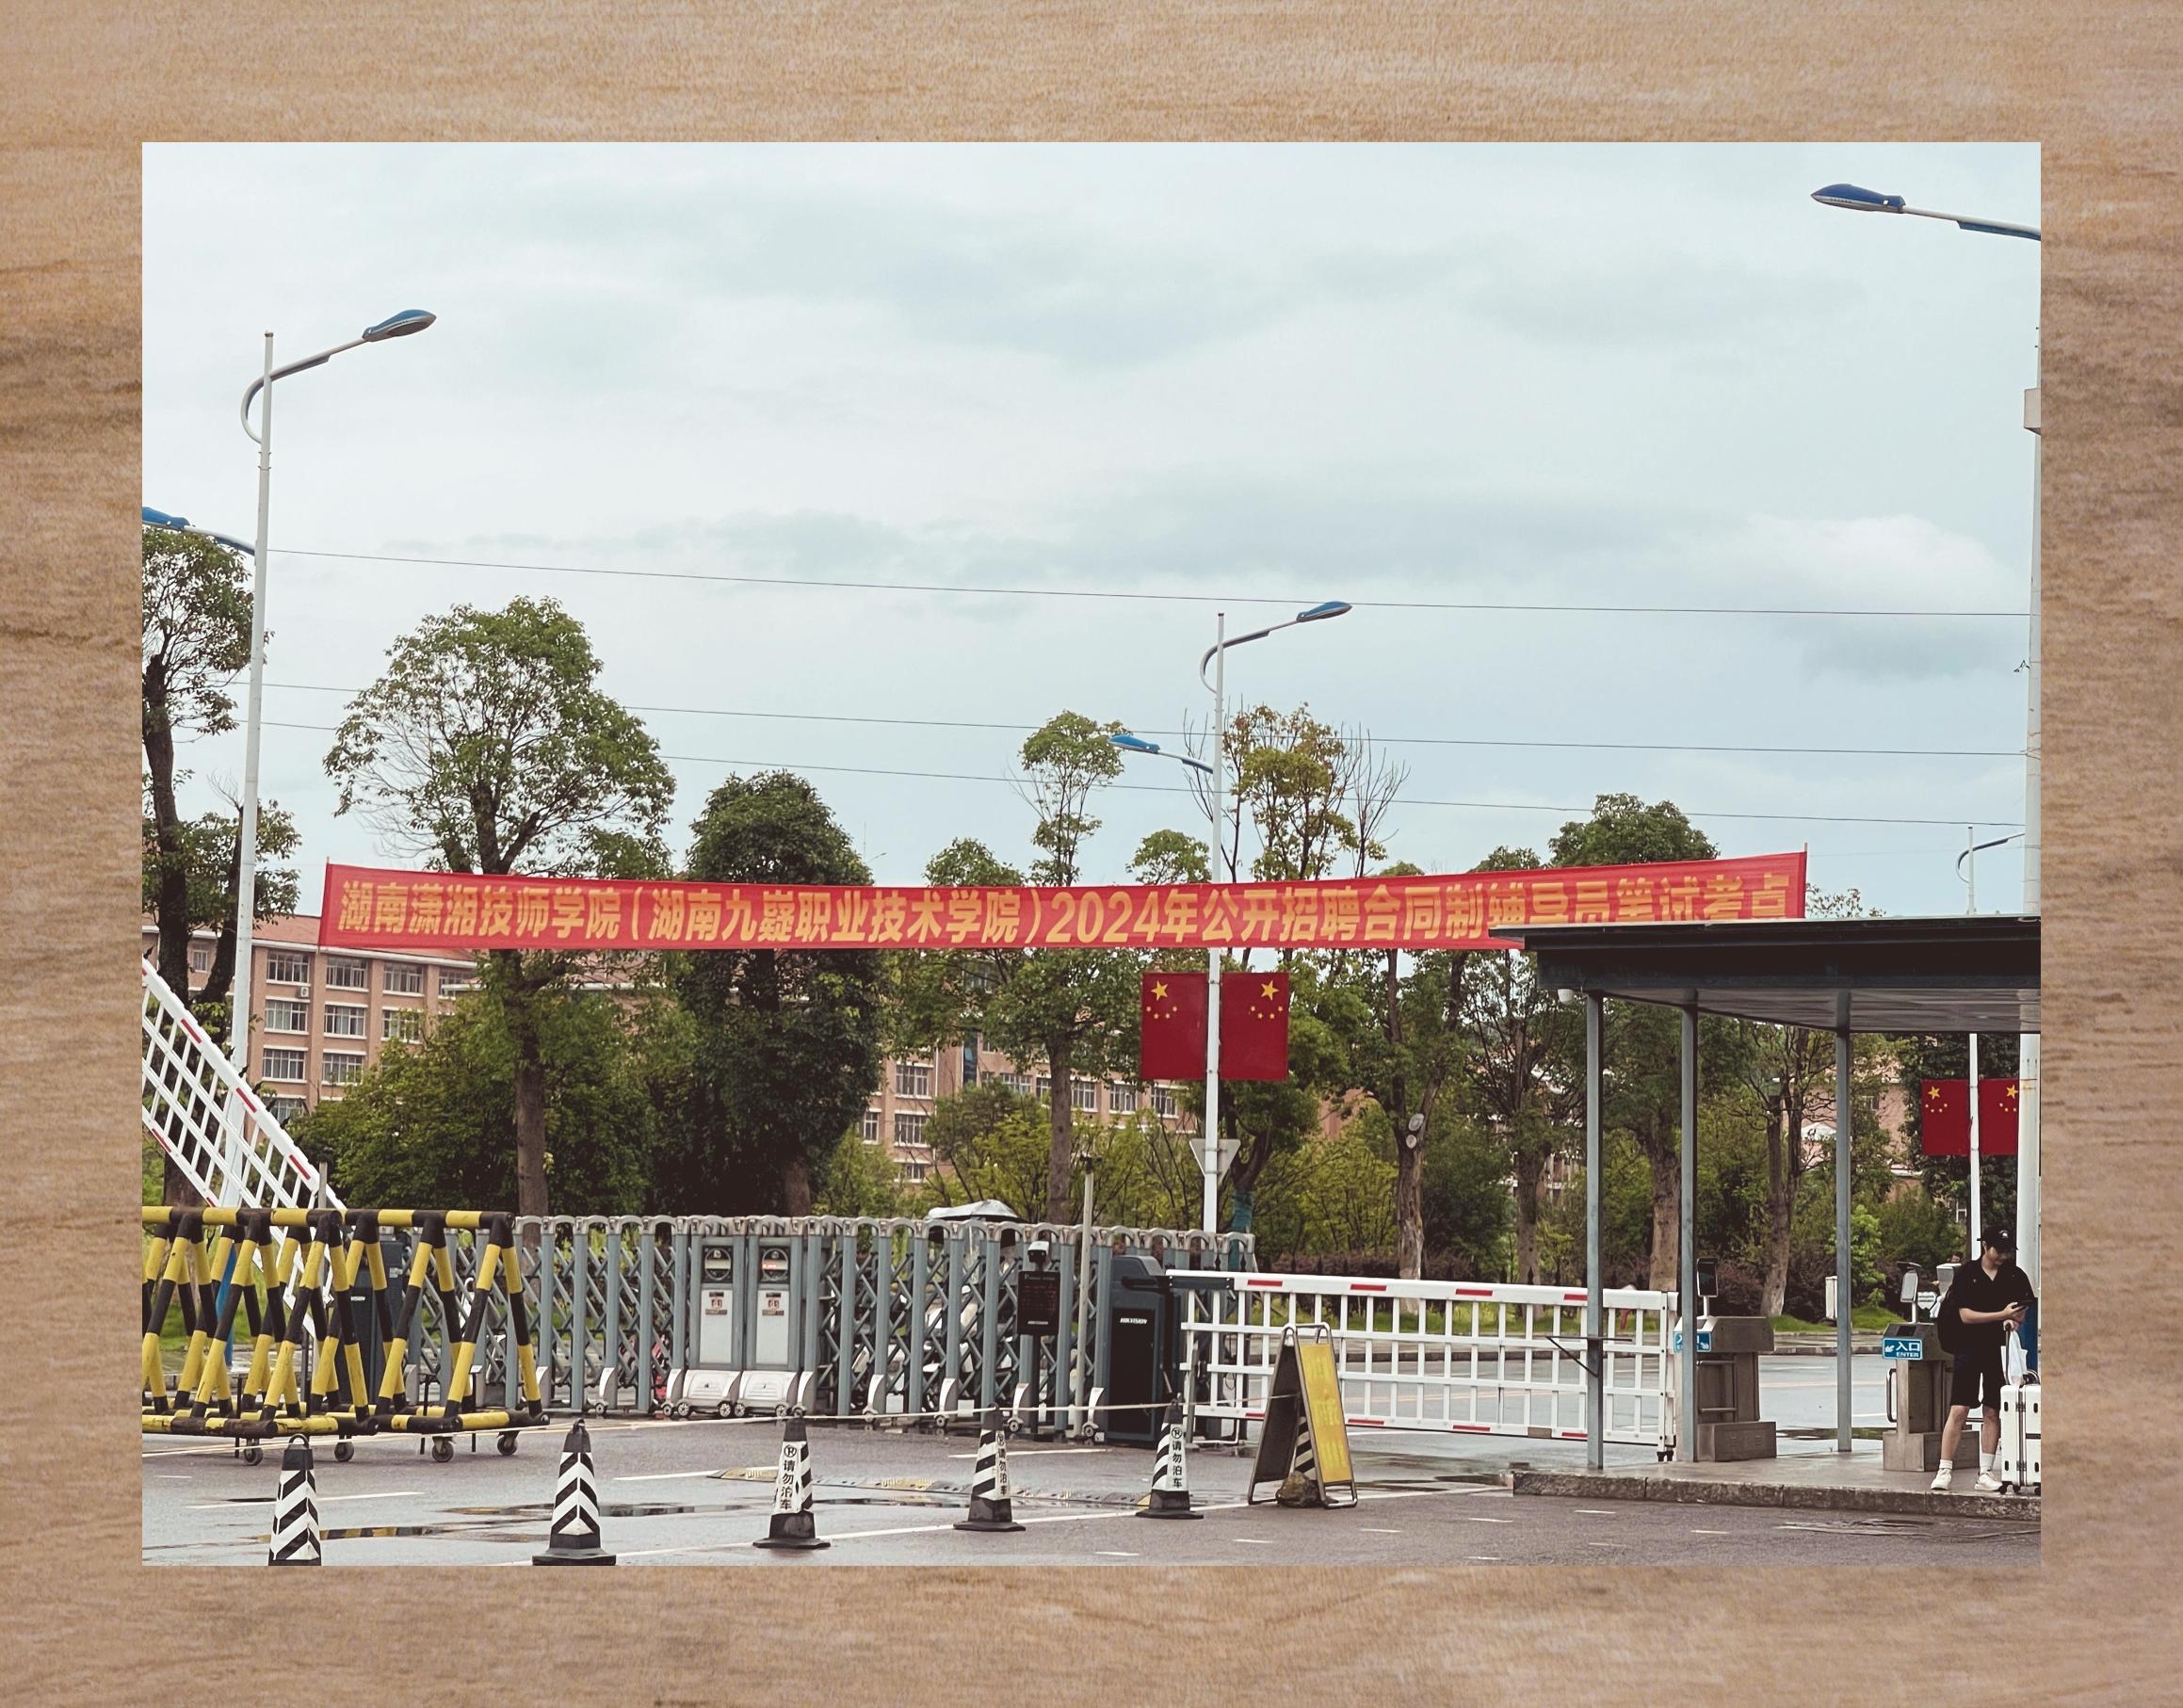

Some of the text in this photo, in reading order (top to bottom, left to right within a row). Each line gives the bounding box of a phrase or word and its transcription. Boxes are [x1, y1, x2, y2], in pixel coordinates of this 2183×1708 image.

[1896, 1341, 1919, 1352] 入口
[780, 1460, 796, 1510] 请勿泊车
[1172, 1441, 1183, 1489] 请勿泊车
